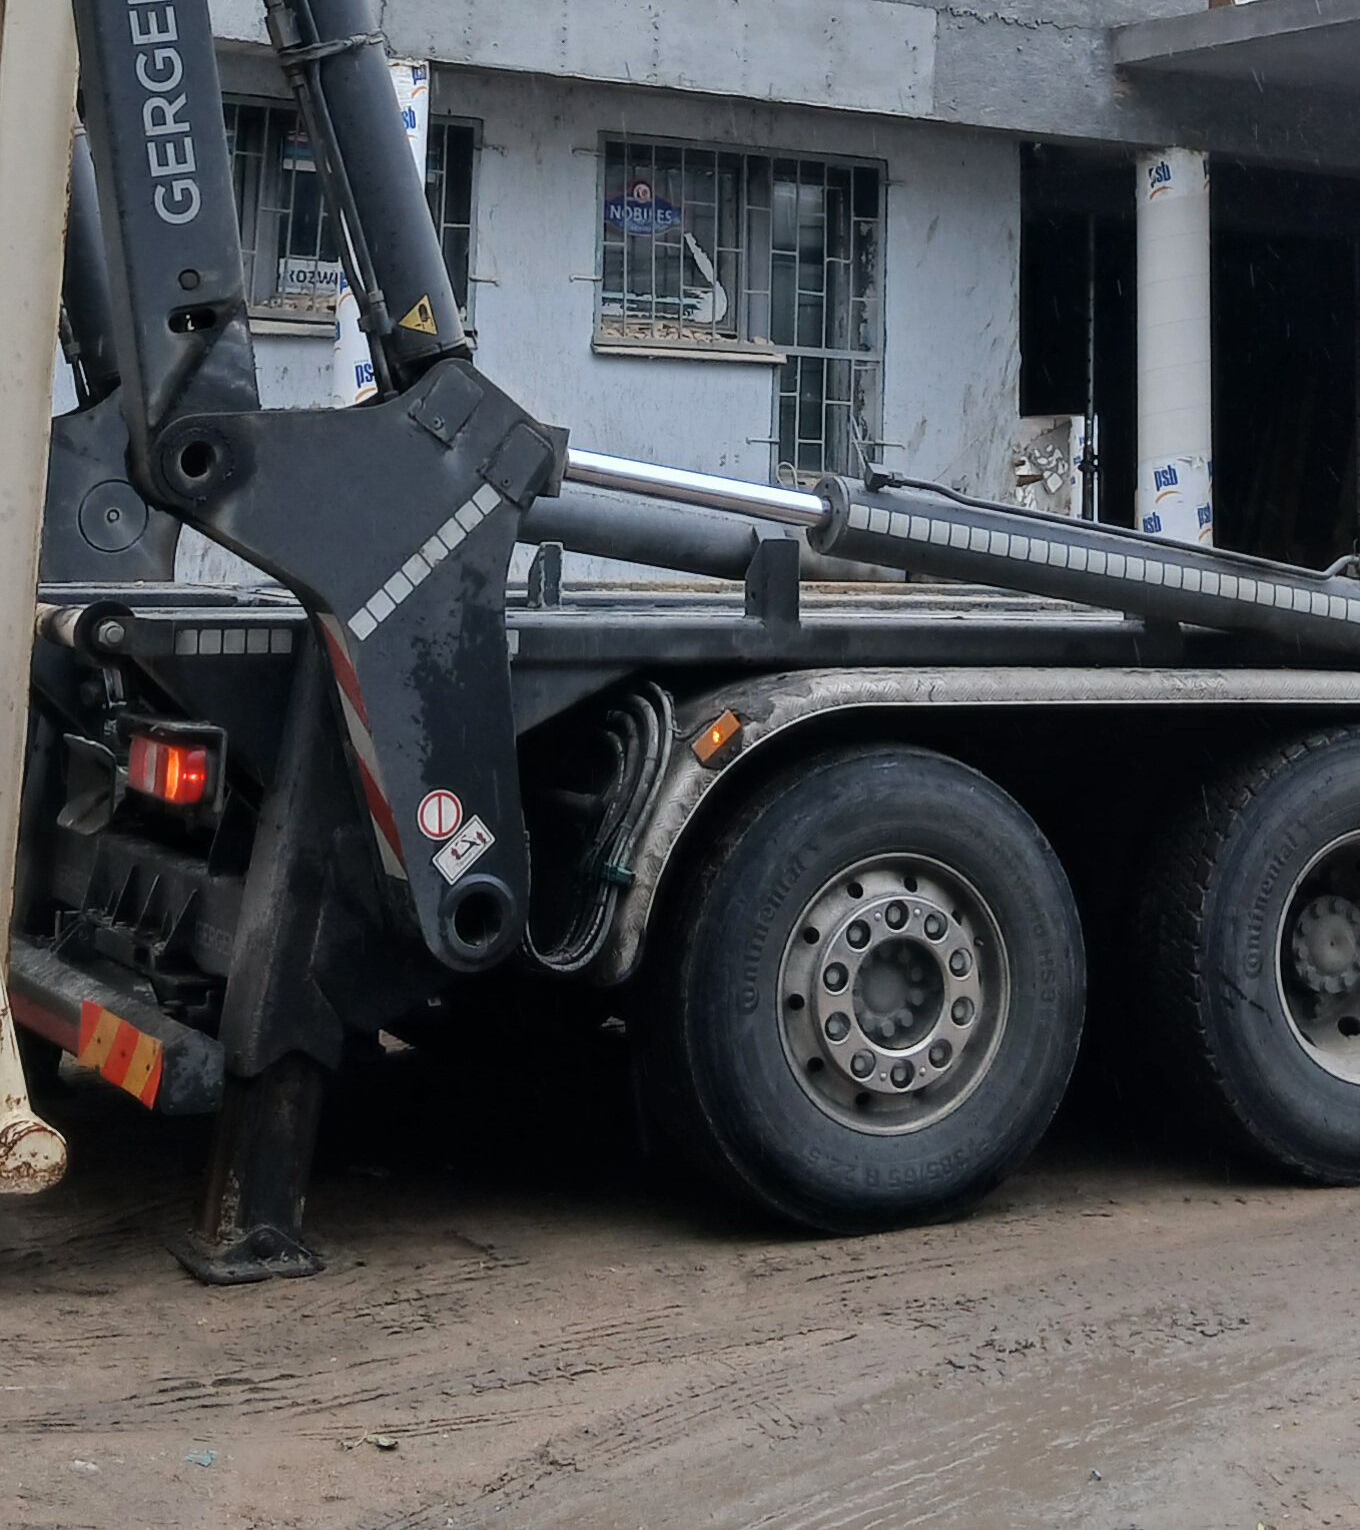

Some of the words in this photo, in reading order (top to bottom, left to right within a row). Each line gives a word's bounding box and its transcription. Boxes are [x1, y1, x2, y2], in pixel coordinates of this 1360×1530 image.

[401, 105, 417, 130] sb
[354, 362, 375, 389] ps
[1154, 463, 1179, 492] psb
